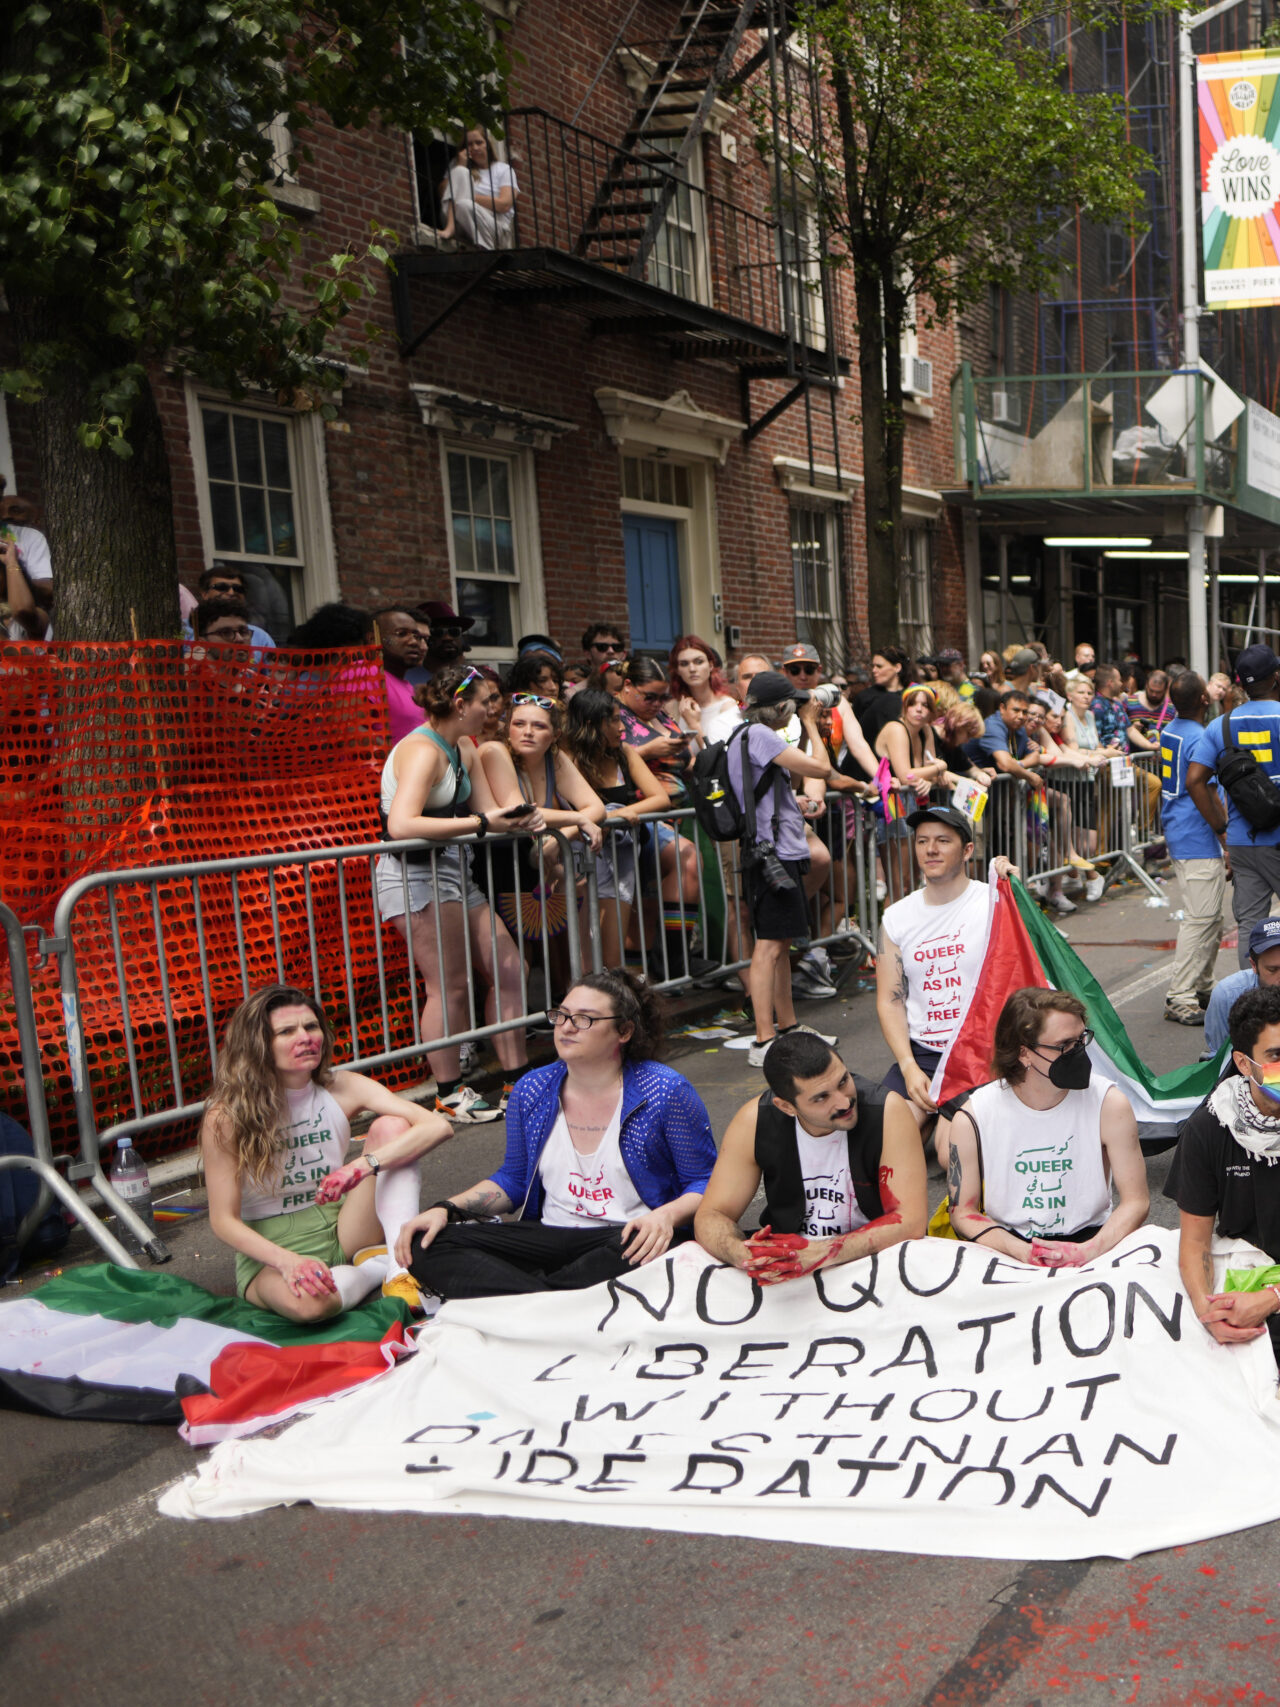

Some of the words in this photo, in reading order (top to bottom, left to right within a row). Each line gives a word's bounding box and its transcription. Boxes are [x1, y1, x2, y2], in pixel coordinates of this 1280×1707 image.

[1220, 147, 1271, 173] Love
[1221, 174, 1272, 202] WINS
[913, 942, 966, 963] QUEER
[922, 979, 943, 992] AS
[945, 975, 963, 989] IN
[927, 1007, 961, 1022] FREE
[1014, 1158, 1074, 1175] QUEER
[280, 1170, 308, 1189] AS
[310, 1165, 331, 1181] IN
[1026, 1175, 1038, 1195] في
[282, 1189, 317, 1209] FRE
[805, 1187, 846, 1205] UEER
[1021, 1196, 1045, 1210] AS
[1048, 1195, 1067, 1210] IN
[800, 1223, 819, 1237] AS
[822, 1224, 842, 1237] IN
[597, 1257, 764, 1333] NO
[812, 1240, 1163, 1313] QUER
[532, 1281, 1184, 1383] LIBERATION
[573, 1373, 1122, 1423] WITHOUT
